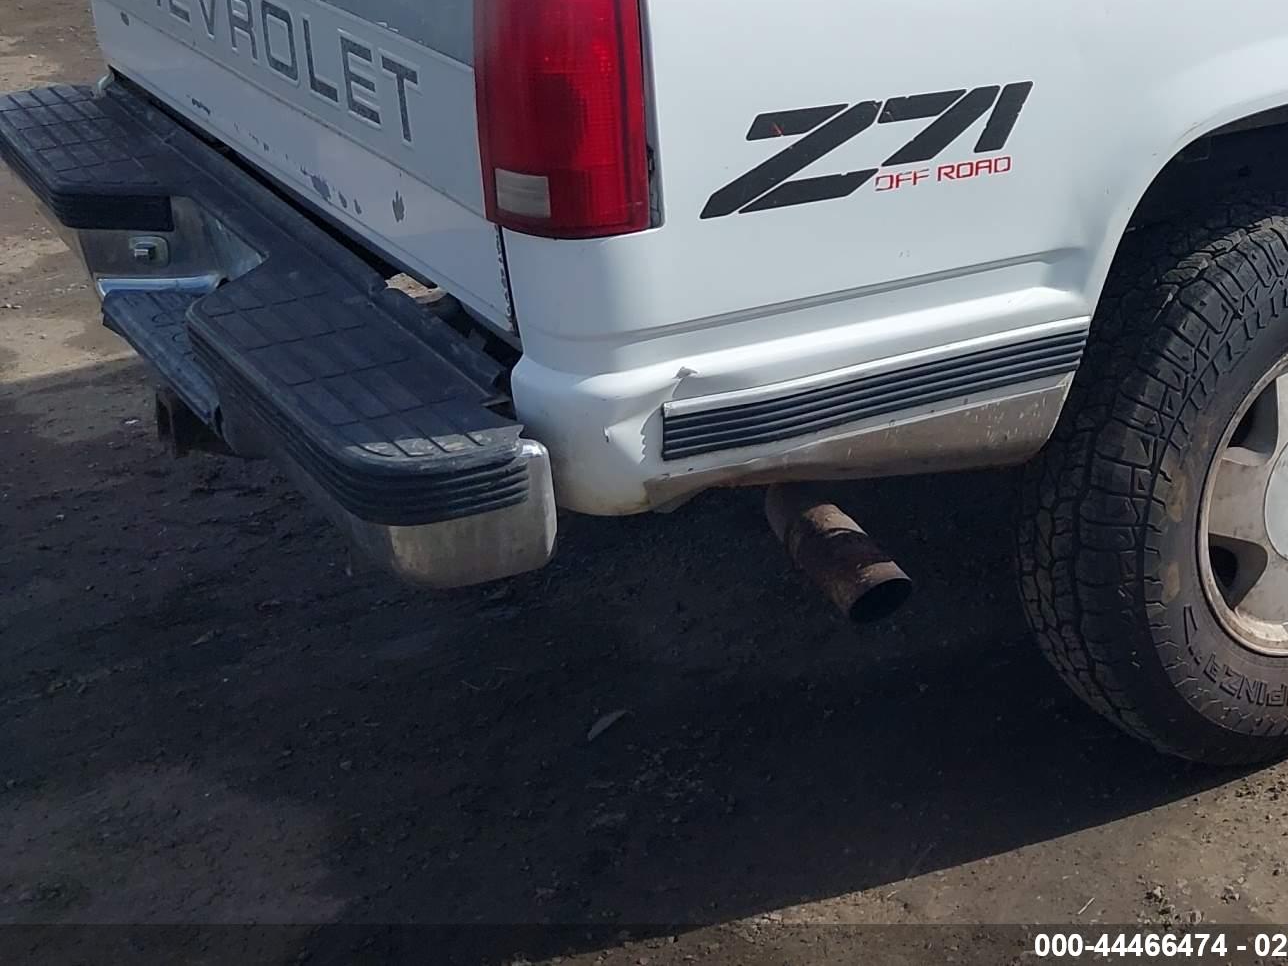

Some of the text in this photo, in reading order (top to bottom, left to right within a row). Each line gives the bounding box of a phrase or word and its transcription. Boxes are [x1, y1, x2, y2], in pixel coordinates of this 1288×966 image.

[699, 80, 1034, 220] Z71
[874, 156, 1012, 192] OFF ROAD
